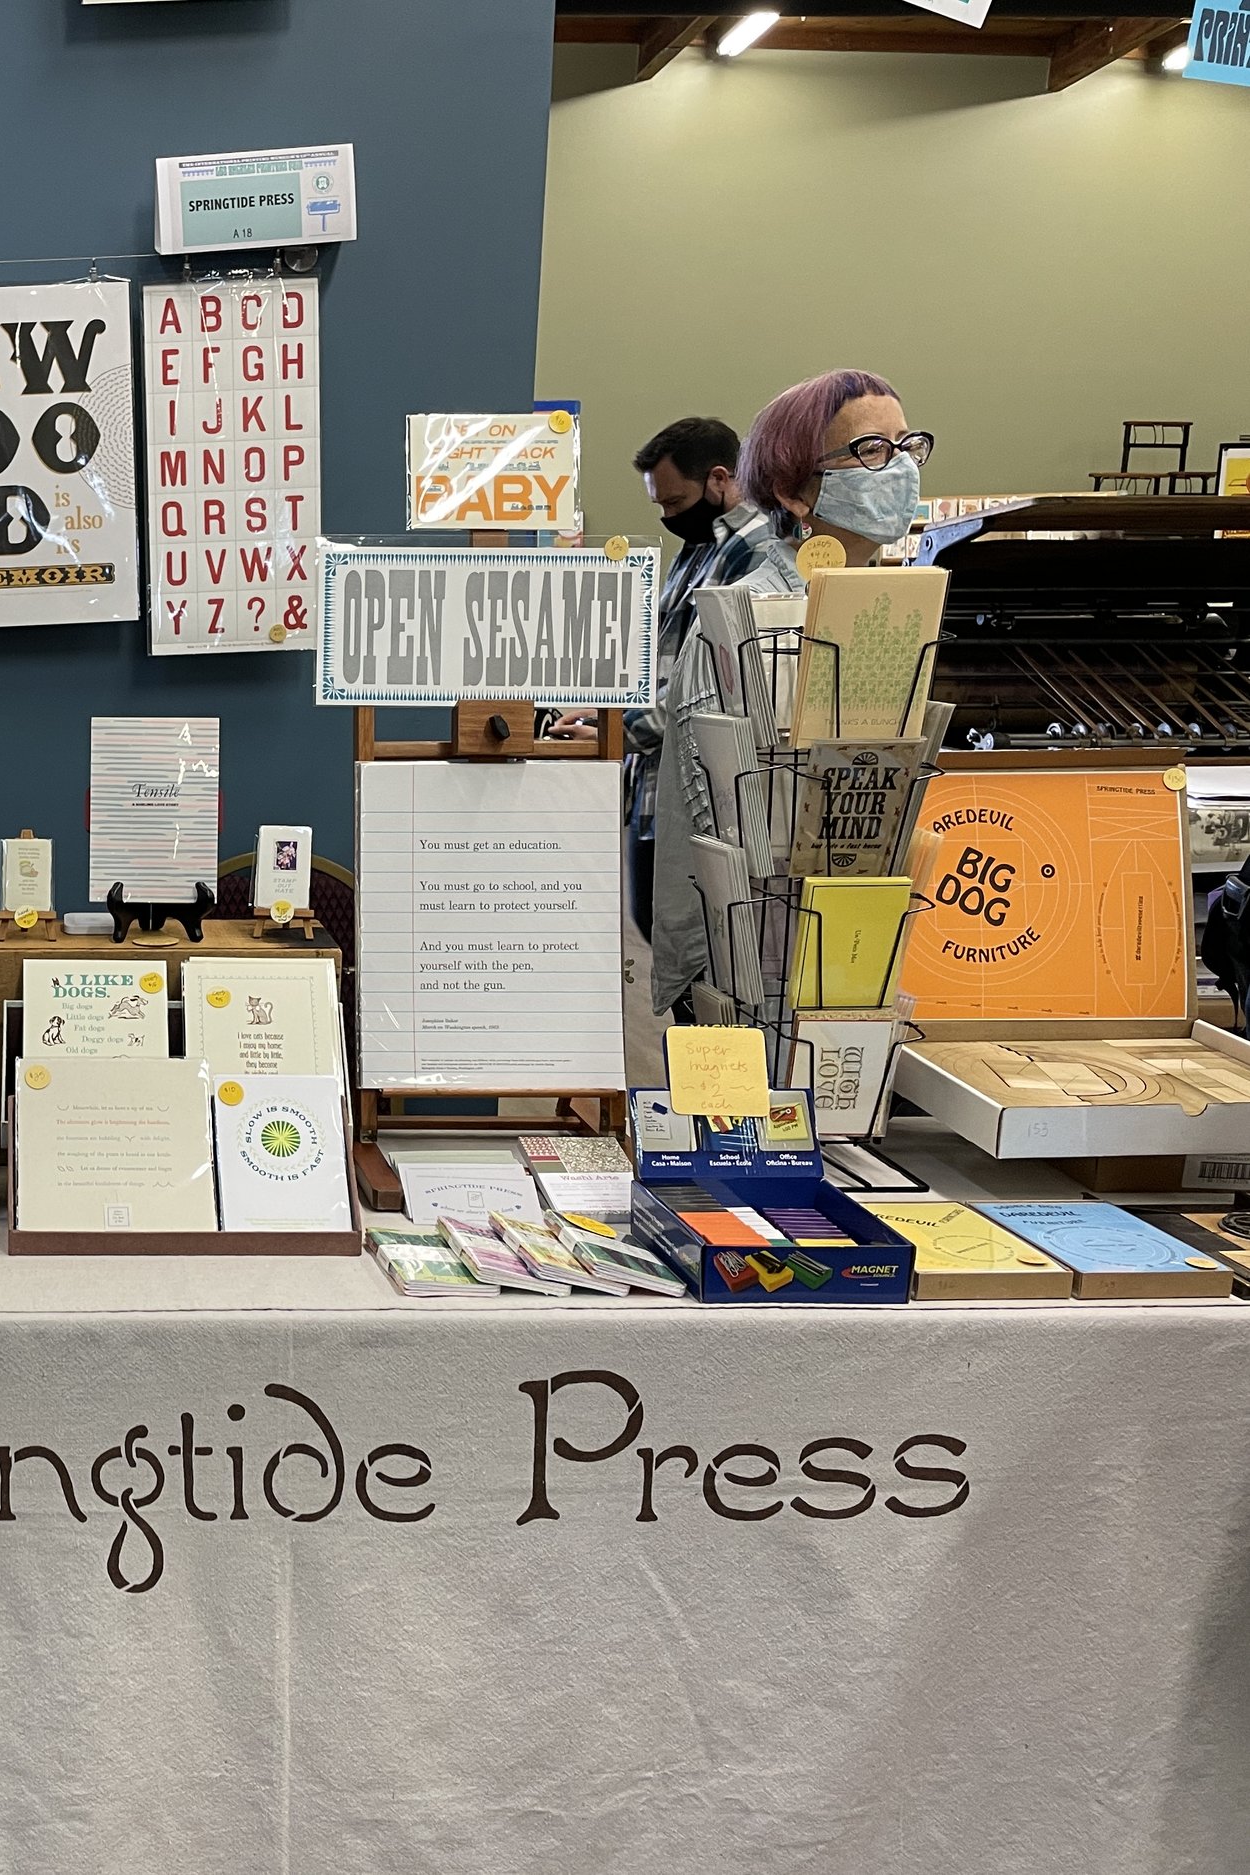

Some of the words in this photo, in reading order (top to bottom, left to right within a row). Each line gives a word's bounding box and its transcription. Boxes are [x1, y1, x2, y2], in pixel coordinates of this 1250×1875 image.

[1193, 8, 1250, 68] PRIN
[189, 196, 255, 212] SPRINGTIDE
[259, 192, 295, 206] PRESS
[233, 229, 240, 238] A
[242, 228, 253, 237] 18
[488, 424, 517, 437] ON
[160, 450, 187, 487] M
[202, 448, 226, 485] N
[244, 446, 266, 482] O
[283, 445, 305, 481] P
[55, 485, 71, 507] is
[415, 474, 571, 522] BABY
[64, 507, 104, 530] also
[342, 569, 447, 686] OPEN
[462, 570, 633, 688] SESAME!
[820, 767, 901, 790] SPEAK
[131, 783, 180, 798] Tensile
[1096, 785, 1133, 794] SPRINGTIDE
[824, 791, 888, 815] YOUR
[817, 816, 883, 840] MIND
[932, 808, 1015, 834] AREDEVIL
[419, 839, 440, 850] You
[444, 841, 470, 850] must
[473, 841, 489, 852] get
[492, 842, 506, 850] an
[509, 839, 562, 850] education.
[956, 846, 1016, 893] BIG
[419, 881, 440, 891] You
[444, 882, 470, 891] must
[473, 883, 486, 893] go
[489, 882, 499, 891] to
[502, 880, 538, 893] school,
[540, 881, 560, 891] and
[563, 883, 583, 893] you
[419, 901, 445, 911] must
[448, 900, 476, 911] learn
[479, 902, 491, 911] to
[493, 900, 530, 913] protect
[534, 900, 578, 913] yourself.
[935, 873, 1011, 927] DOG
[420, 941, 442, 951] And
[445, 943, 464, 953] you
[467, 942, 493, 951] must
[497, 941, 524, 951] learn
[528, 942, 539, 951] to
[542, 941, 579, 953] protect
[941, 926, 1041, 963] FURNITURE
[420, 960, 462, 973] yourself
[464, 961, 488, 971] with
[491, 961, 509, 971] the
[512, 963, 534, 973] pen,
[64, 974, 74, 985] I
[79, 974, 134, 986] LIKE
[420, 980, 439, 990] and
[442, 981, 460, 990] not
[463, 980, 480, 990] the
[483, 982, 506, 992] gun.
[53, 986, 111, 998] DOGS.
[62, 1002, 75, 1010] Big
[76, 1002, 93, 1010] dogs
[685, 1042, 730, 1060] Super
[690, 1061, 748, 1079] magnets
[701, 1099, 734, 1110] each
[245, 1110, 263, 1145] SLOW
[266, 1105, 279, 1114] IS
[281, 1105, 318, 1146] SMOOTH
[239, 1149, 286, 1182] SMOOTH
[287, 1173, 300, 1182] IS
[302, 1148, 326, 1178] FAST
[851, 1265, 899, 1274] MAGNET
[516, 1370, 970, 1527] Press
